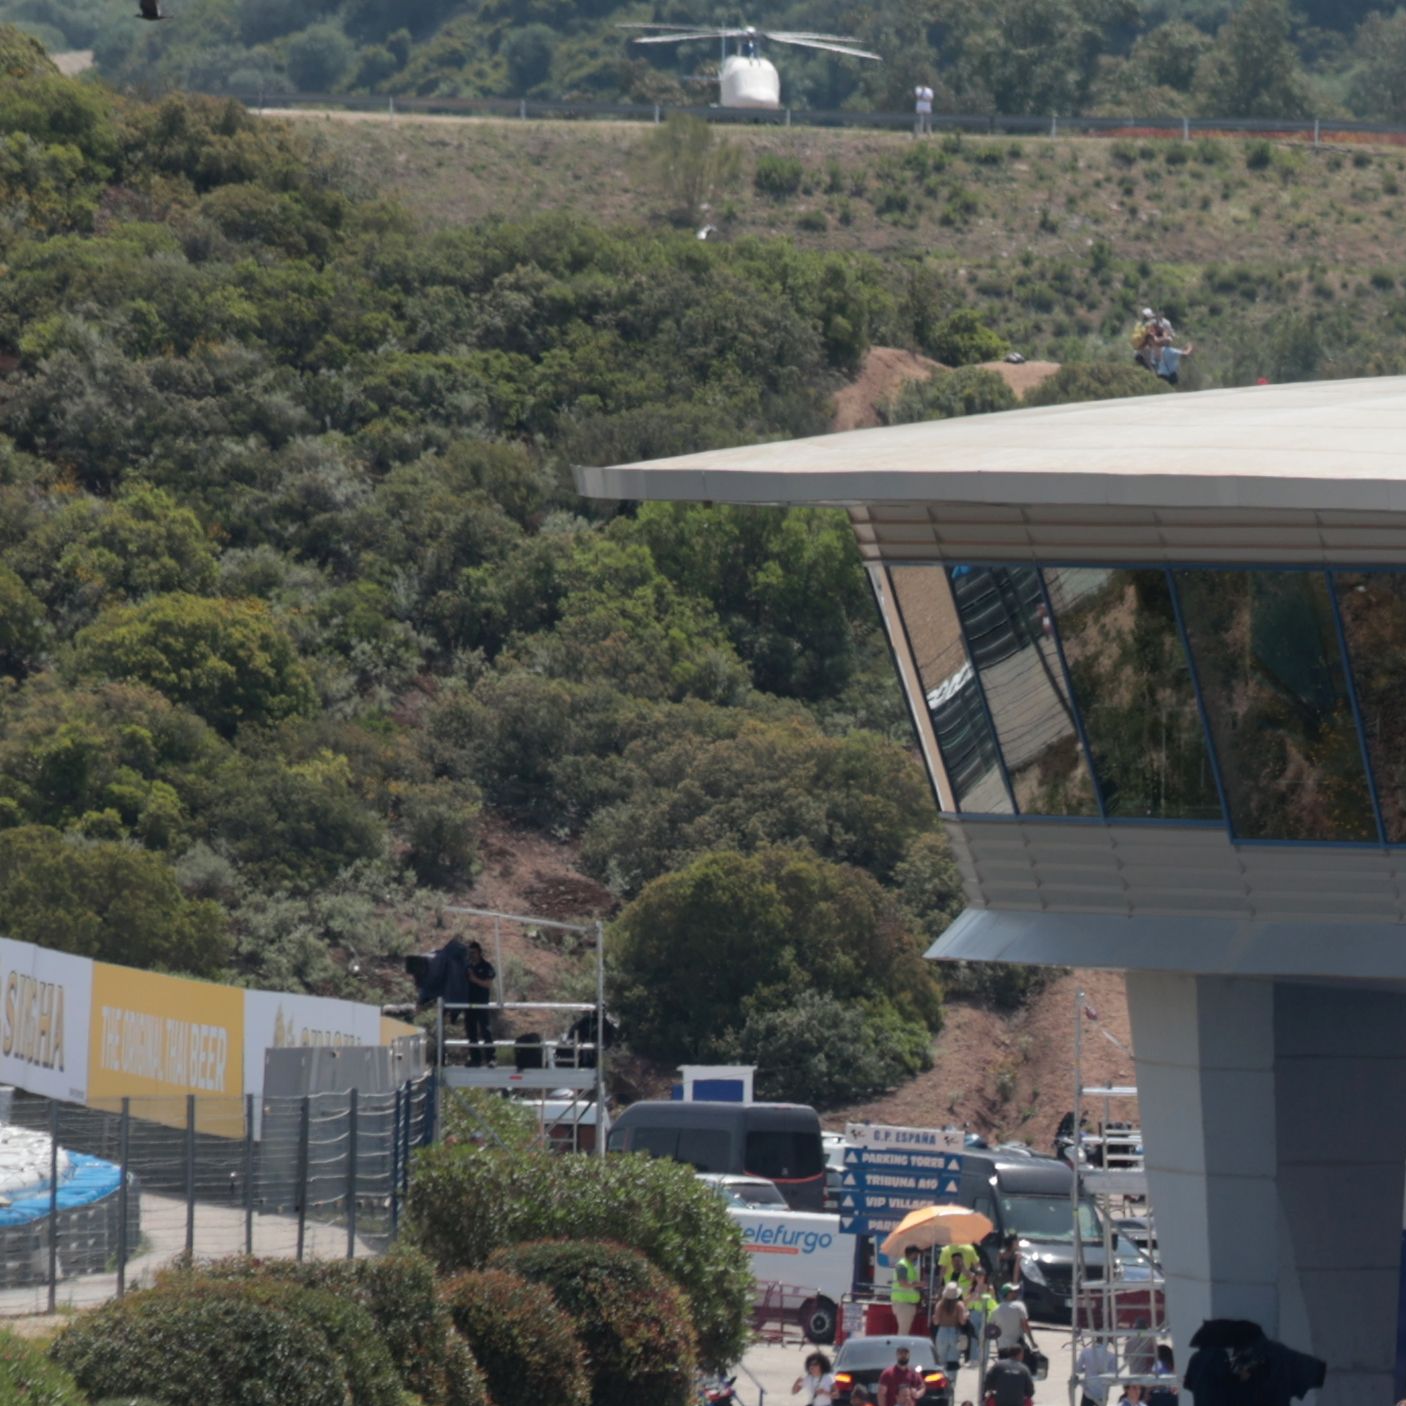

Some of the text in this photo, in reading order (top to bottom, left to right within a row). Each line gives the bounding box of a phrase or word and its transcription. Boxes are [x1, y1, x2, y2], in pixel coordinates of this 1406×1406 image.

[190, 1022, 227, 1093] BEER
[895, 1132, 936, 1145] ESPAÑA
[862, 1153, 908, 1166] PARKING
[865, 1174, 916, 1188] TRIBUNA
[865, 1196, 886, 1207] VIP
[743, 1224, 832, 1254] elefurgo
